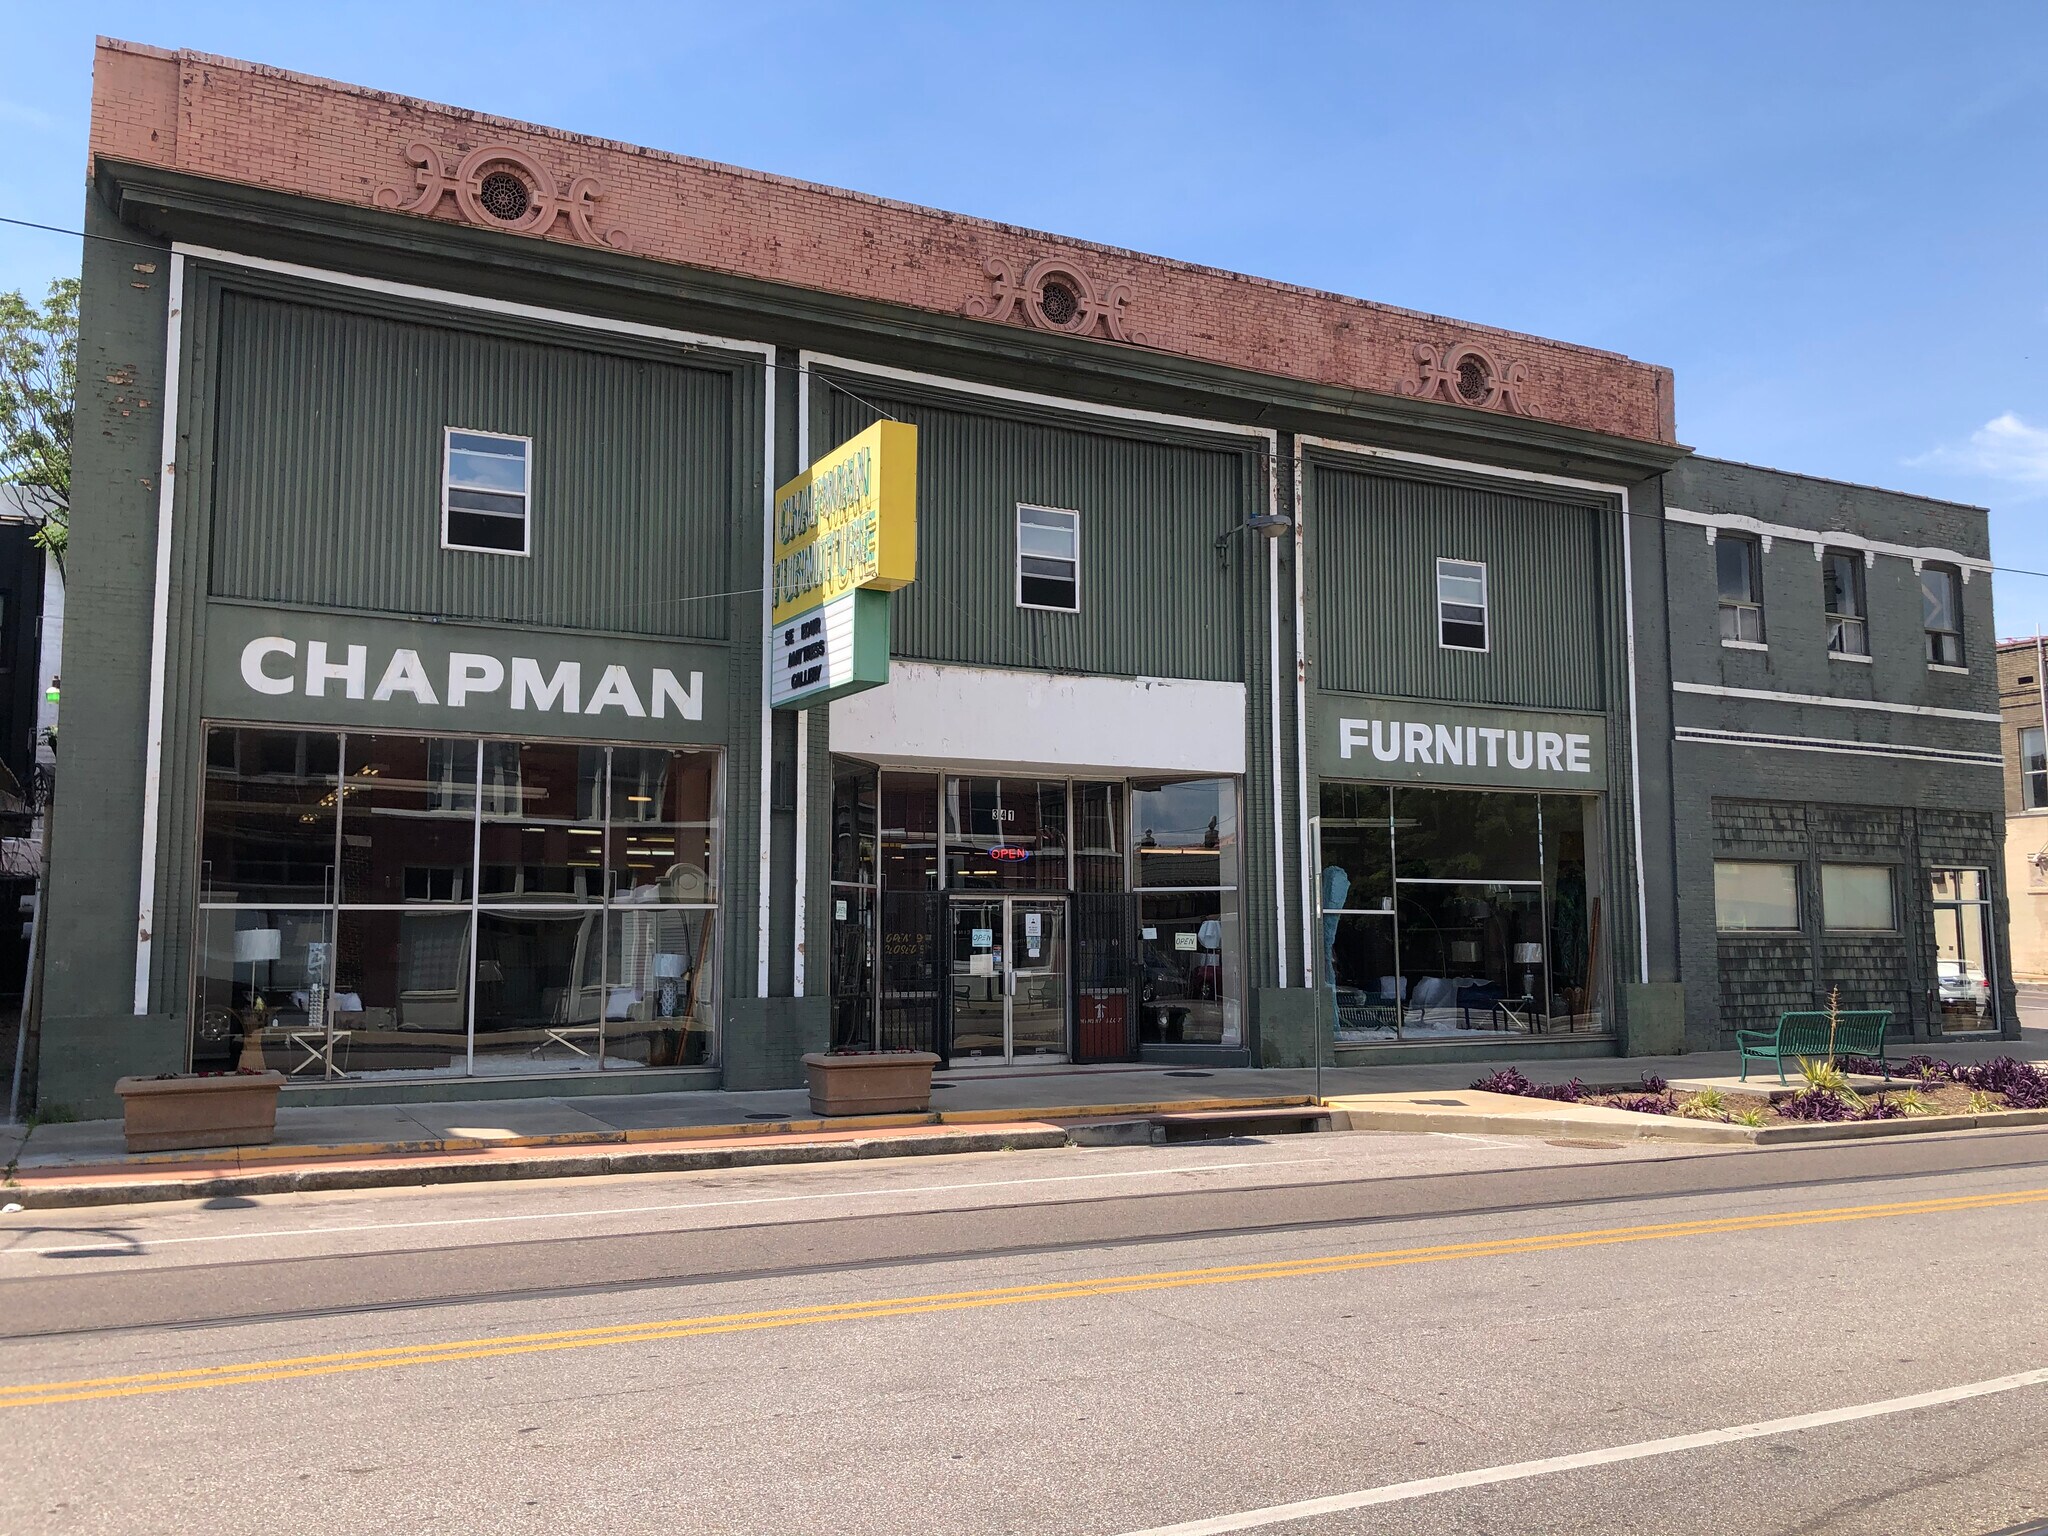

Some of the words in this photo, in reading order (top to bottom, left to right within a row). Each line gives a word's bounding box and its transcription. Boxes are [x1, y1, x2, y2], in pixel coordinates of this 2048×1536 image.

[776, 446, 872, 547] CHAPMAN
[772, 511, 876, 609] FURNITURE
[240, 636, 704, 721] CHAPMAN
[1339, 717, 1591, 773] FURNITURE
[992, 809, 1015, 821] 341
[991, 848, 1025, 859] OPEN
[973, 933, 991, 942] OPEN
[1175, 937, 1195, 945] OPEN
